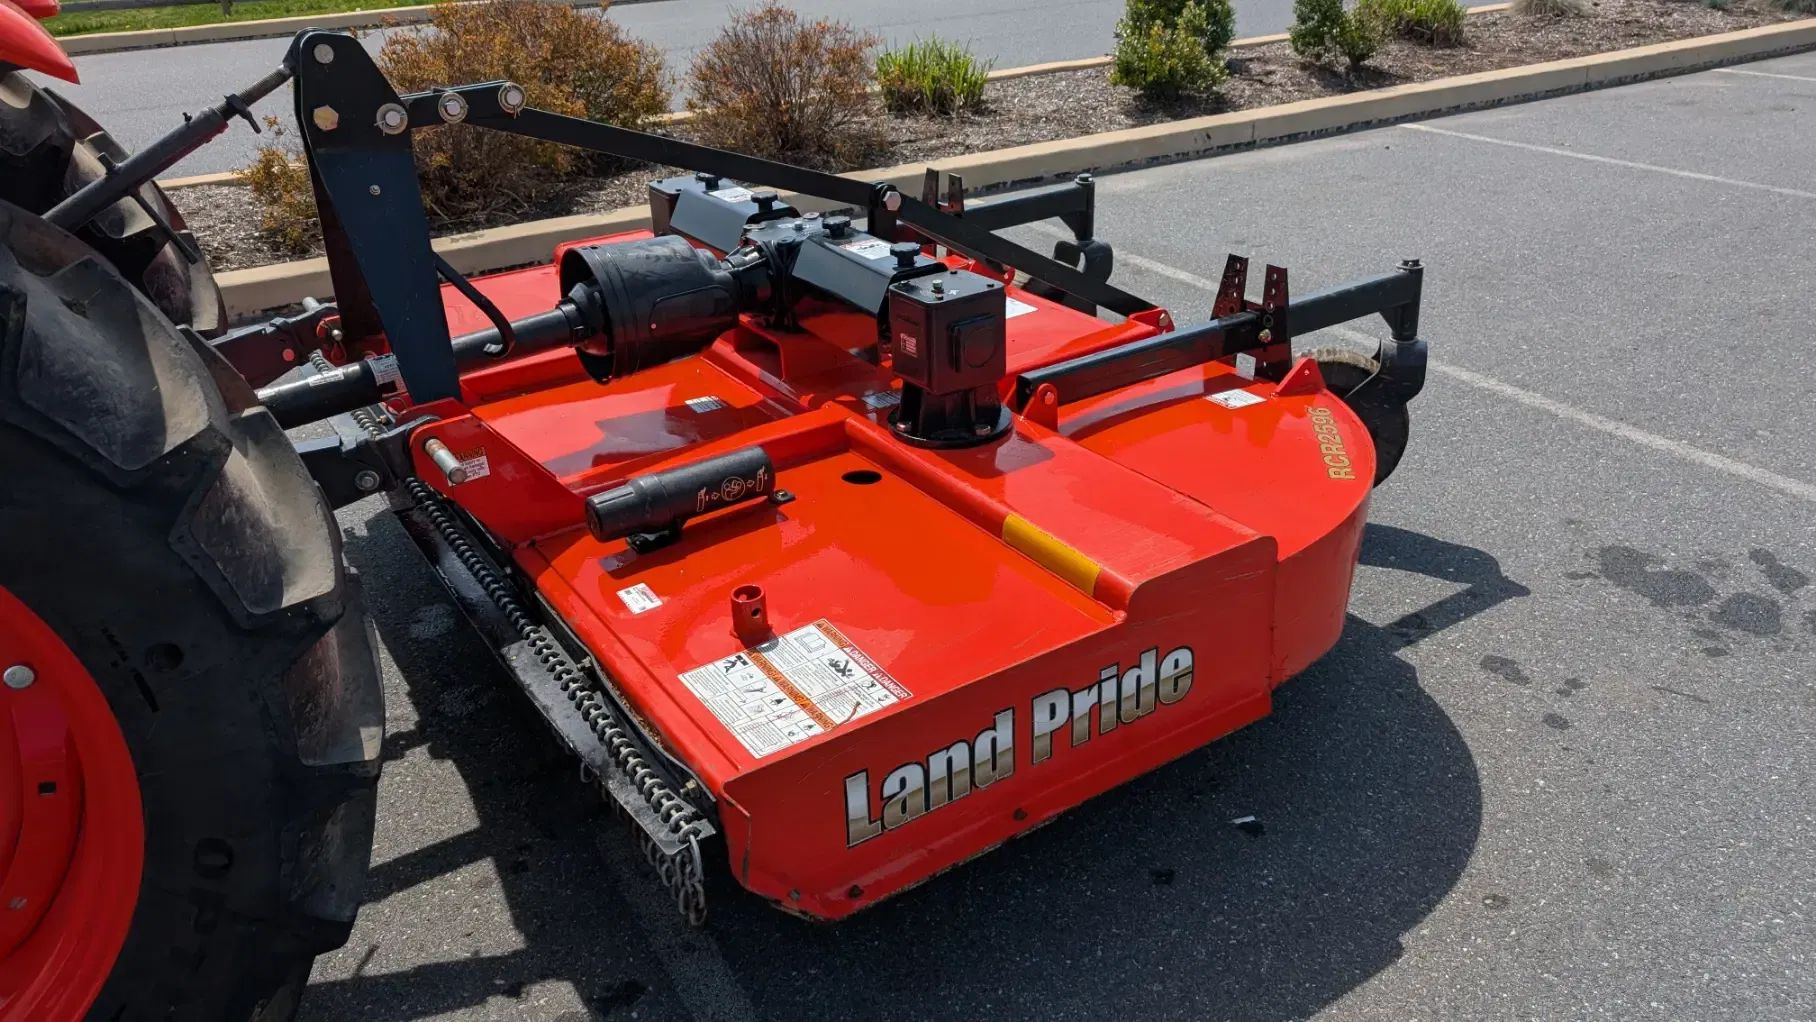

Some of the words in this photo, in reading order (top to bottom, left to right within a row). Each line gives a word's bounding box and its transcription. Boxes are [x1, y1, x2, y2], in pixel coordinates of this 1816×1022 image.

[1307, 406, 1356, 480] RCR2596
[819, 625, 849, 647] WARNING
[750, 654, 778, 675] WARNING
[847, 649, 878, 672] DANGER
[777, 679, 805, 702] WARNING
[877, 675, 907, 699] DANGER
[804, 705, 834, 729] WARNING
[844, 706, 1016, 850] Land
[1031, 645, 1194, 766] Pride
